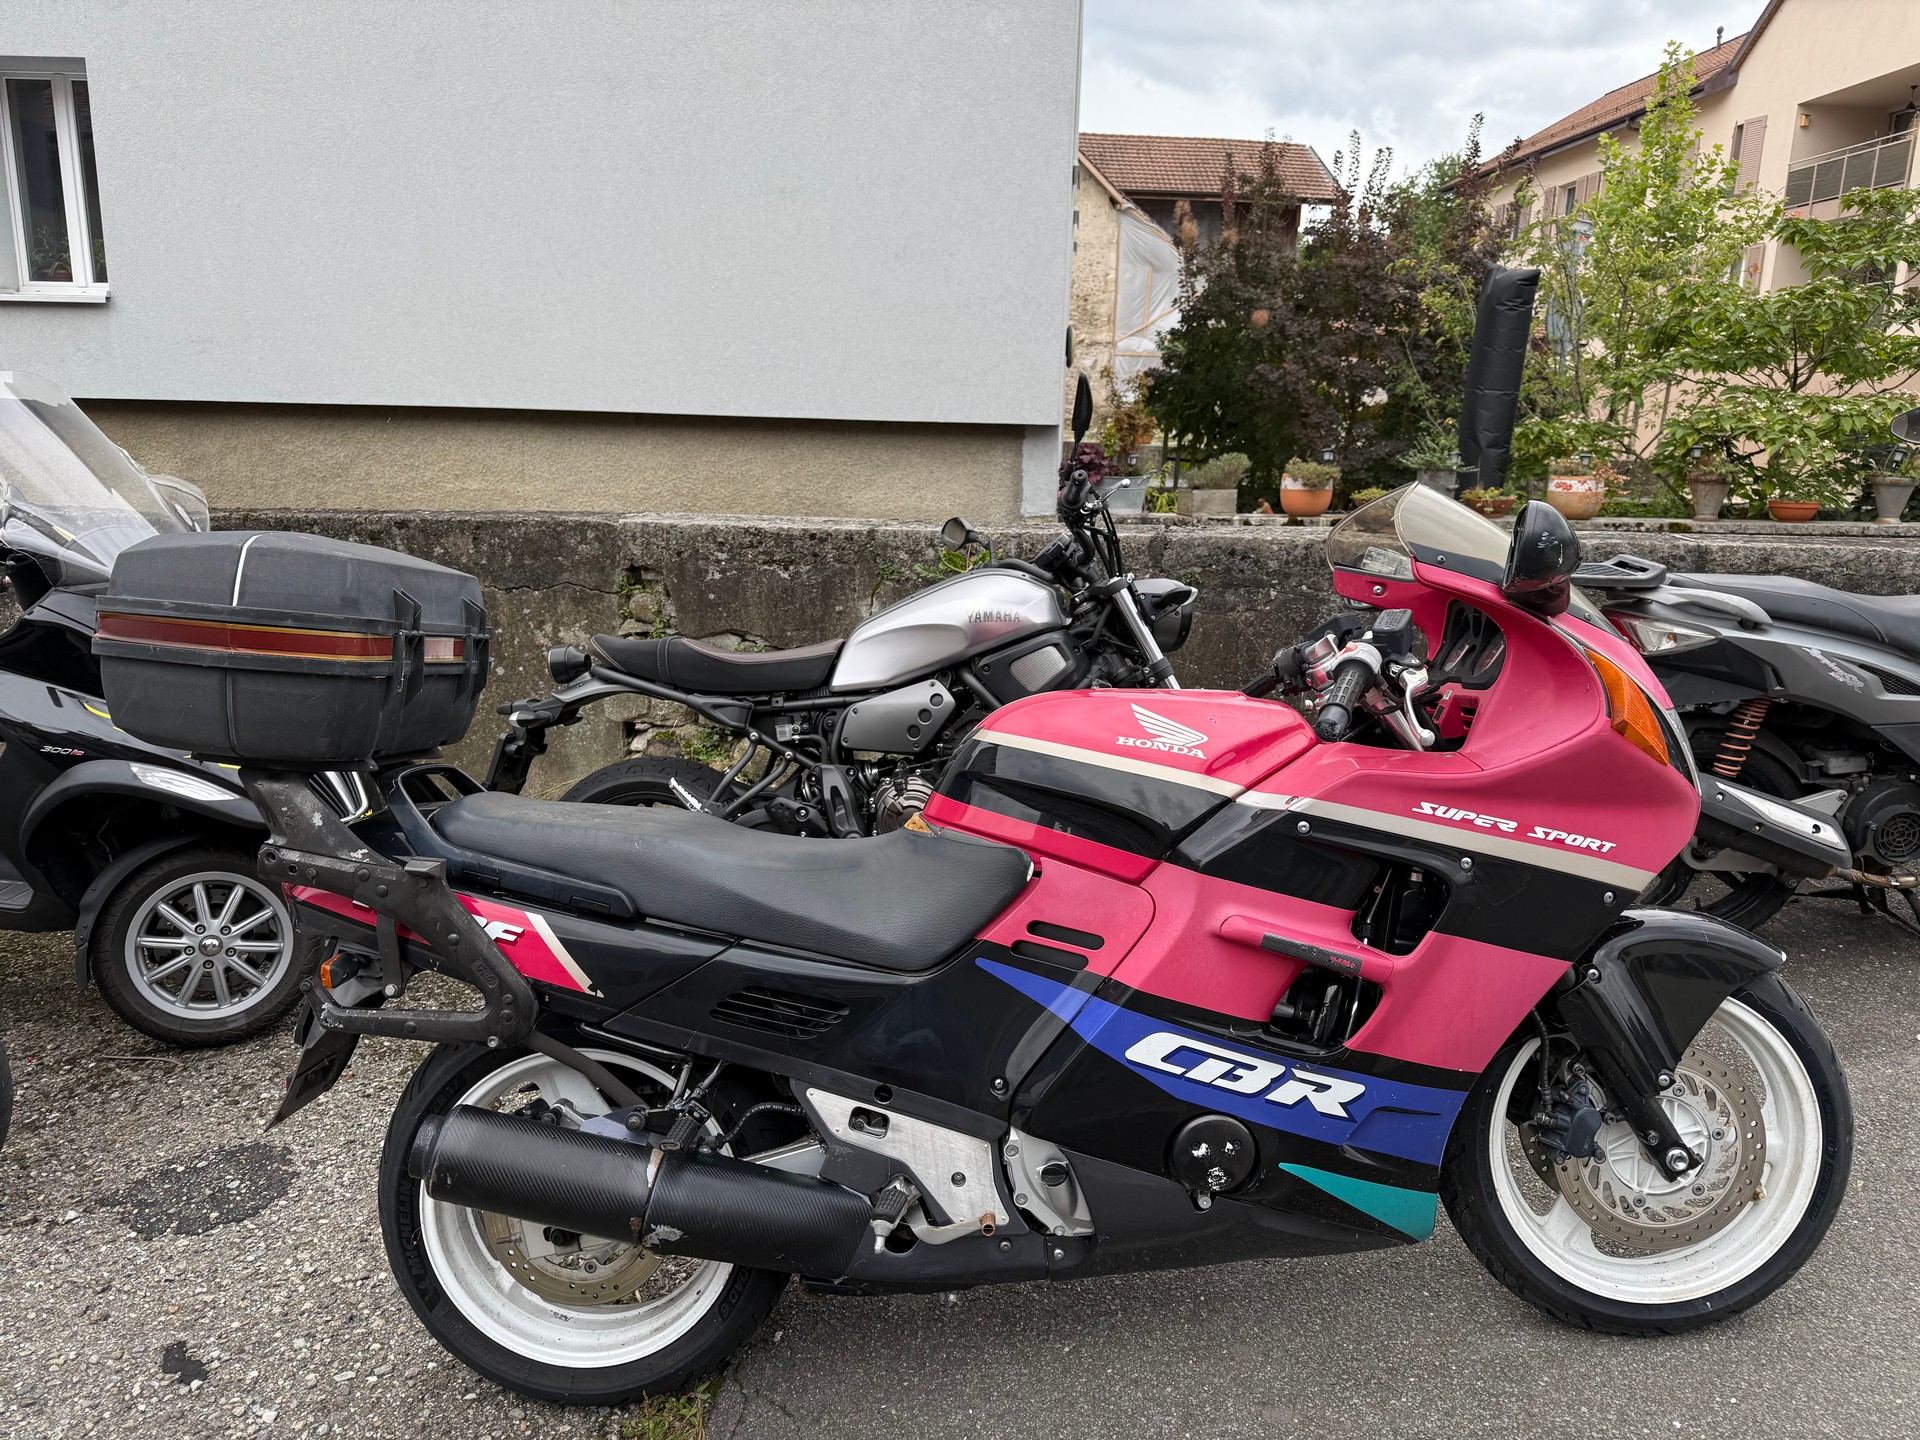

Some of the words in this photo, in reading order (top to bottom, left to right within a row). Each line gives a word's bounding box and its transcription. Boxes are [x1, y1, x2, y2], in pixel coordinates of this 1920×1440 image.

[966, 608, 1021, 624] YAMAHA
[1116, 736, 1207, 760] HONDA
[1411, 801, 1519, 833] SUPER
[1527, 826, 1617, 853] SPORT
[1124, 1032, 1367, 1119] CBR
[399, 1179, 427, 1278] MICHELIN
